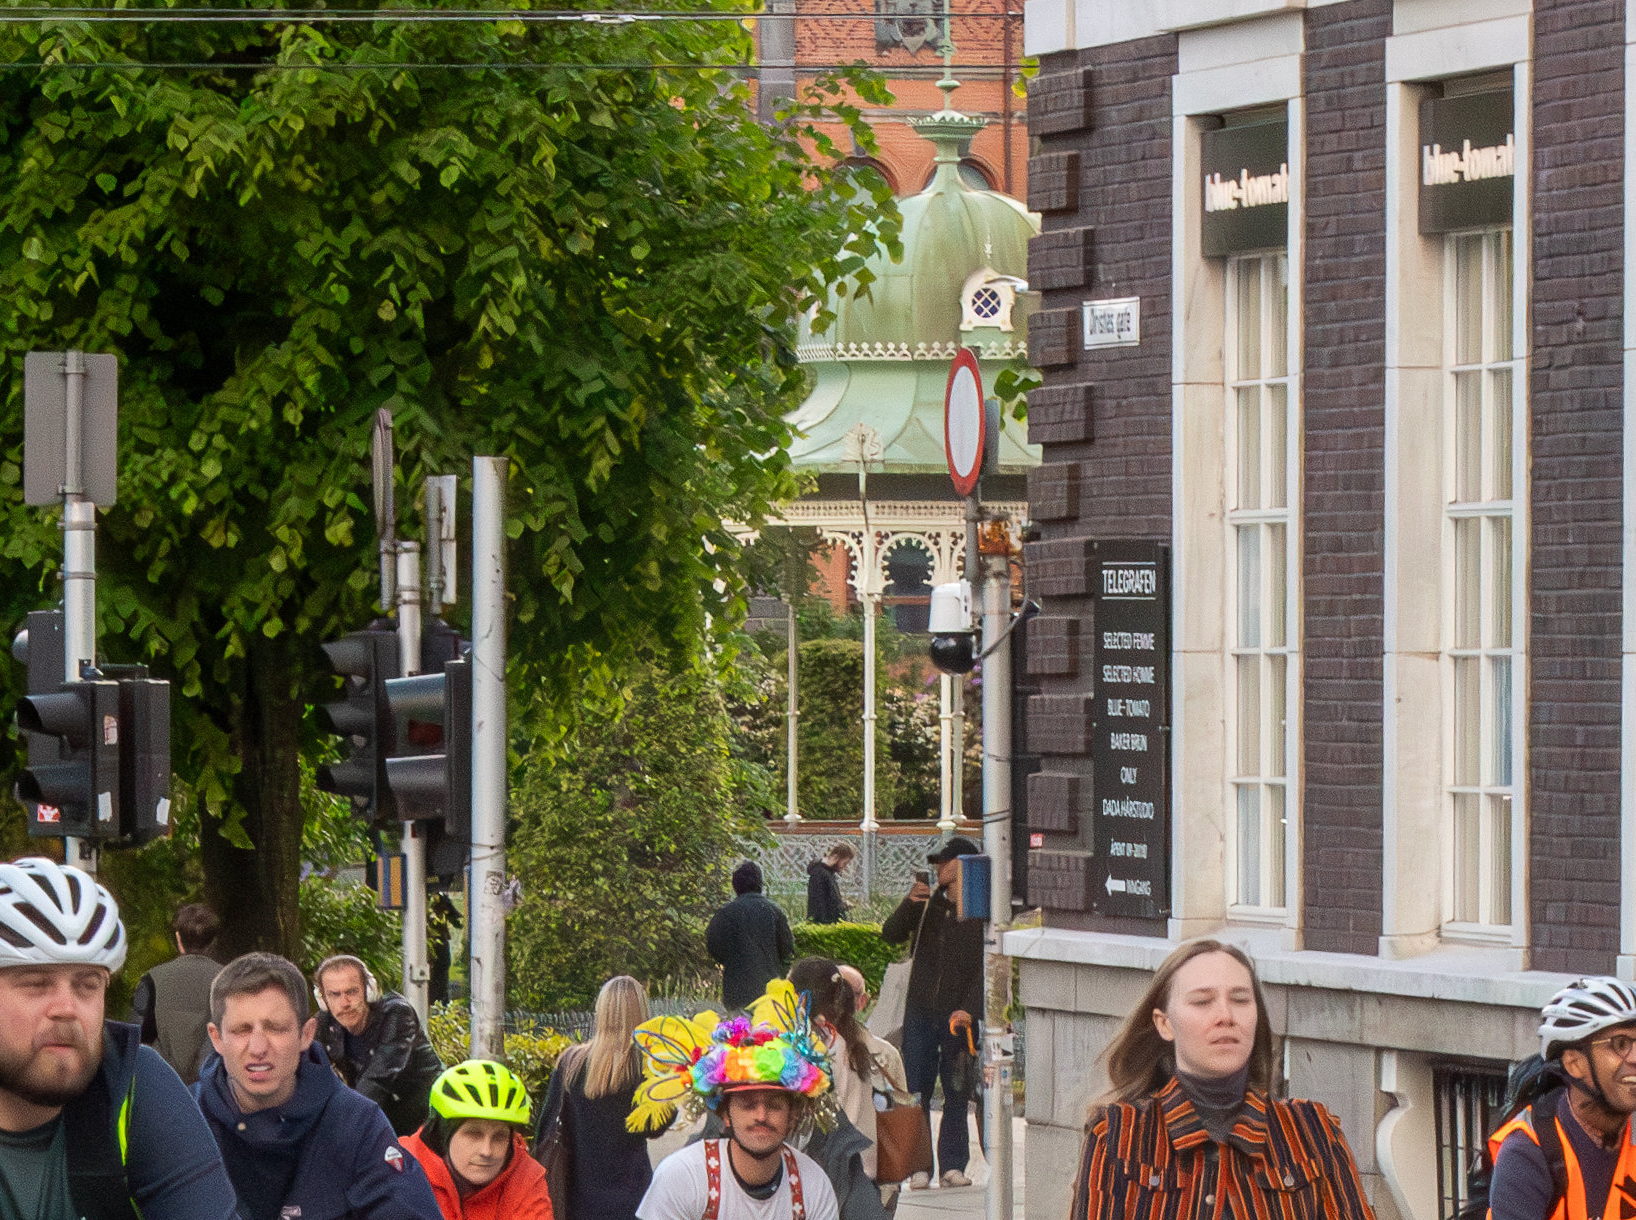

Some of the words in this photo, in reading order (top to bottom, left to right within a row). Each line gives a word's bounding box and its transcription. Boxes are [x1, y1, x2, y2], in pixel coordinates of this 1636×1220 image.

[1423, 133, 1514, 186] blue-tomat
[1205, 162, 1288, 212] blue-tomat
[1102, 569, 1156, 594] TELEGRAFEN
[1103, 631, 1132, 650] SELECTED
[1133, 632, 1155, 650] FEMME
[1103, 665, 1132, 683] SELECTED
[1120, 766, 1138, 784] ONLY
